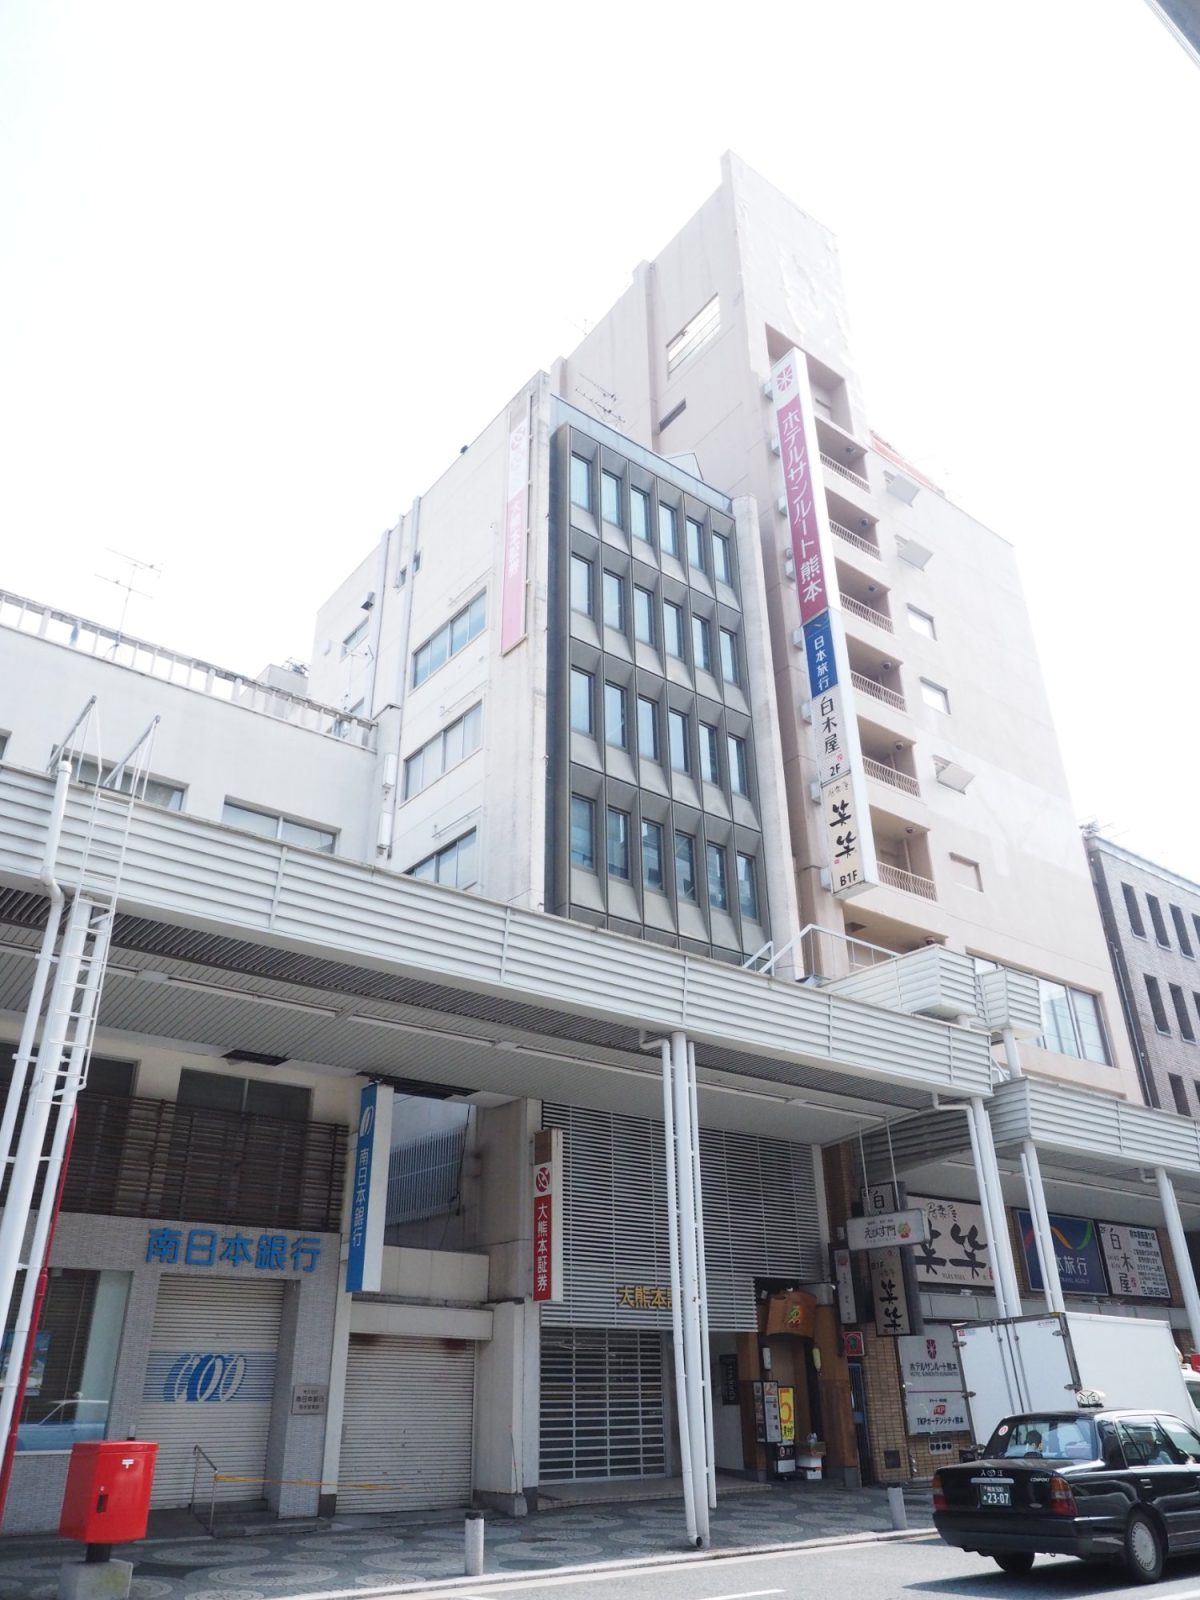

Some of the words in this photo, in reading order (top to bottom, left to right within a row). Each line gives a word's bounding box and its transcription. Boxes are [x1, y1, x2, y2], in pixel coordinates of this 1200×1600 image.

[782, 408, 823, 604] ホテルサンルート熊本
[813, 635, 830, 692] 日本旅行
[820, 695, 841, 755] 白木屋
[829, 763, 841, 777] 2F
[839, 869, 858, 887] B1F
[352, 1148, 369, 1248] 南日本銀行
[145, 1227, 321, 1273] 南日本銀行
[536, 1202, 548, 1292] 大熊本証券
[1110, 1227, 1134, 1293] 白木屋
[987, 1492, 1009, 1505] 23-07
